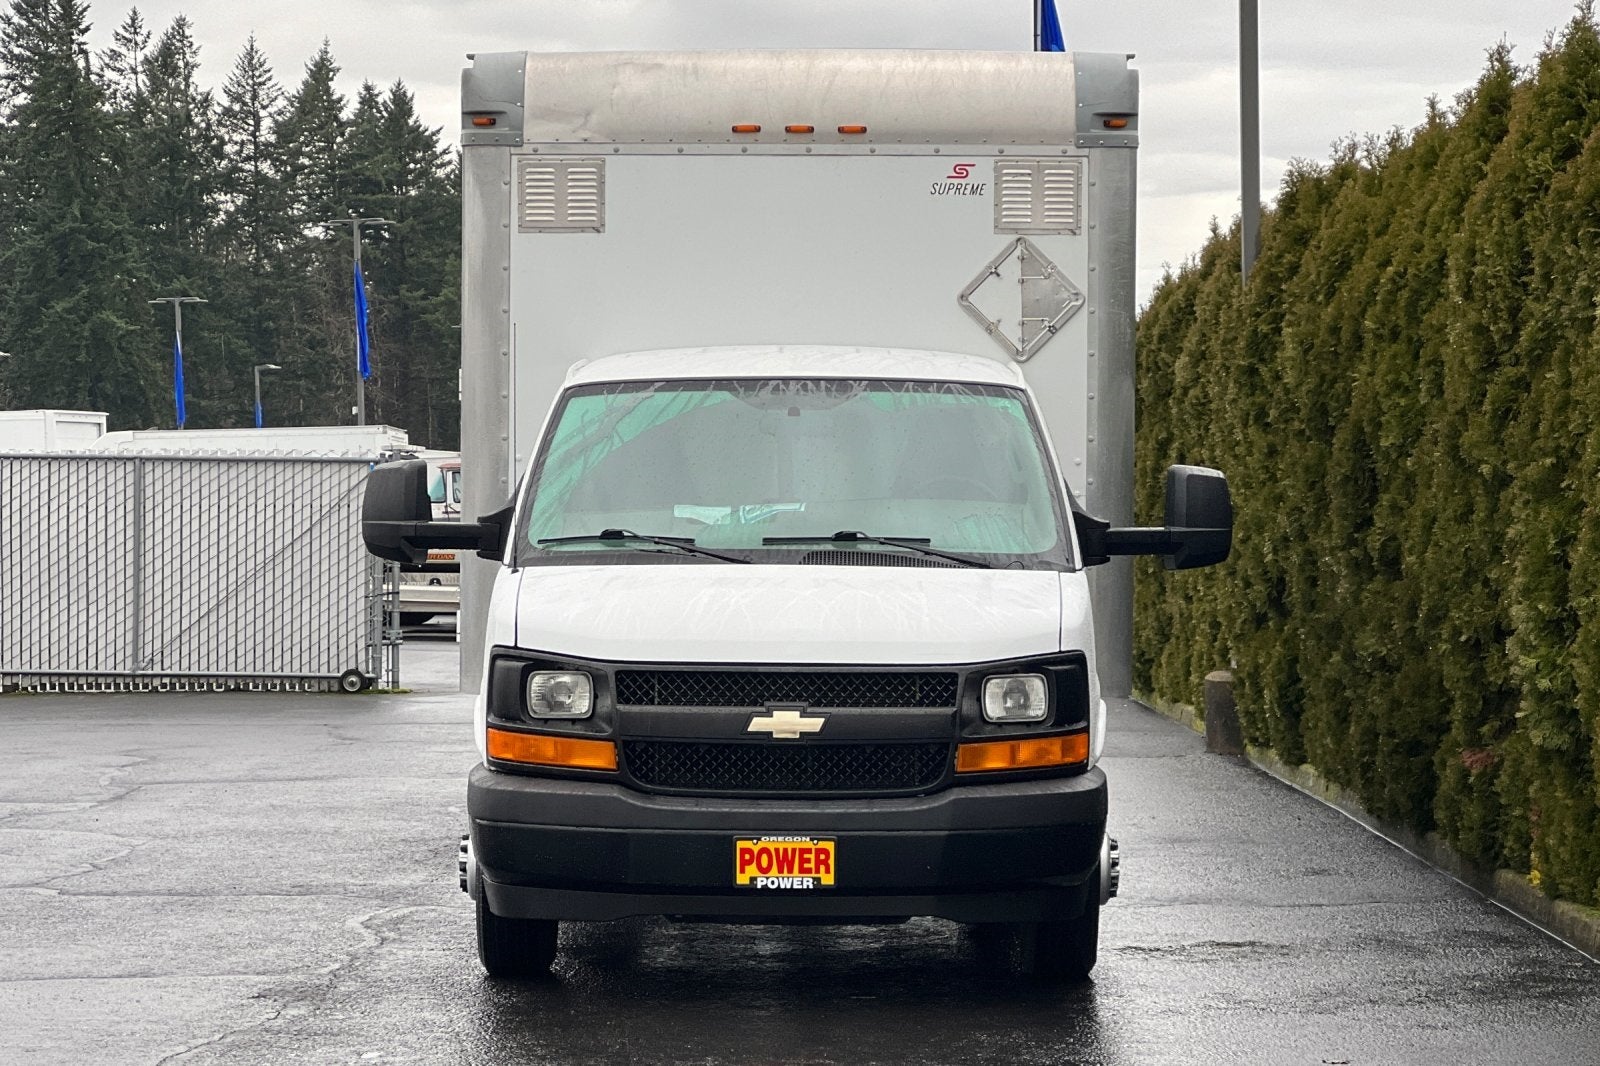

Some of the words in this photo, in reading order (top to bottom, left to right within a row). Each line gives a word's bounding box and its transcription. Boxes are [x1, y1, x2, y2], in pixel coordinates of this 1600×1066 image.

[930, 182, 987, 196] SUPREME
[740, 847, 831, 875] POWER
[757, 877, 814, 889] POWER
